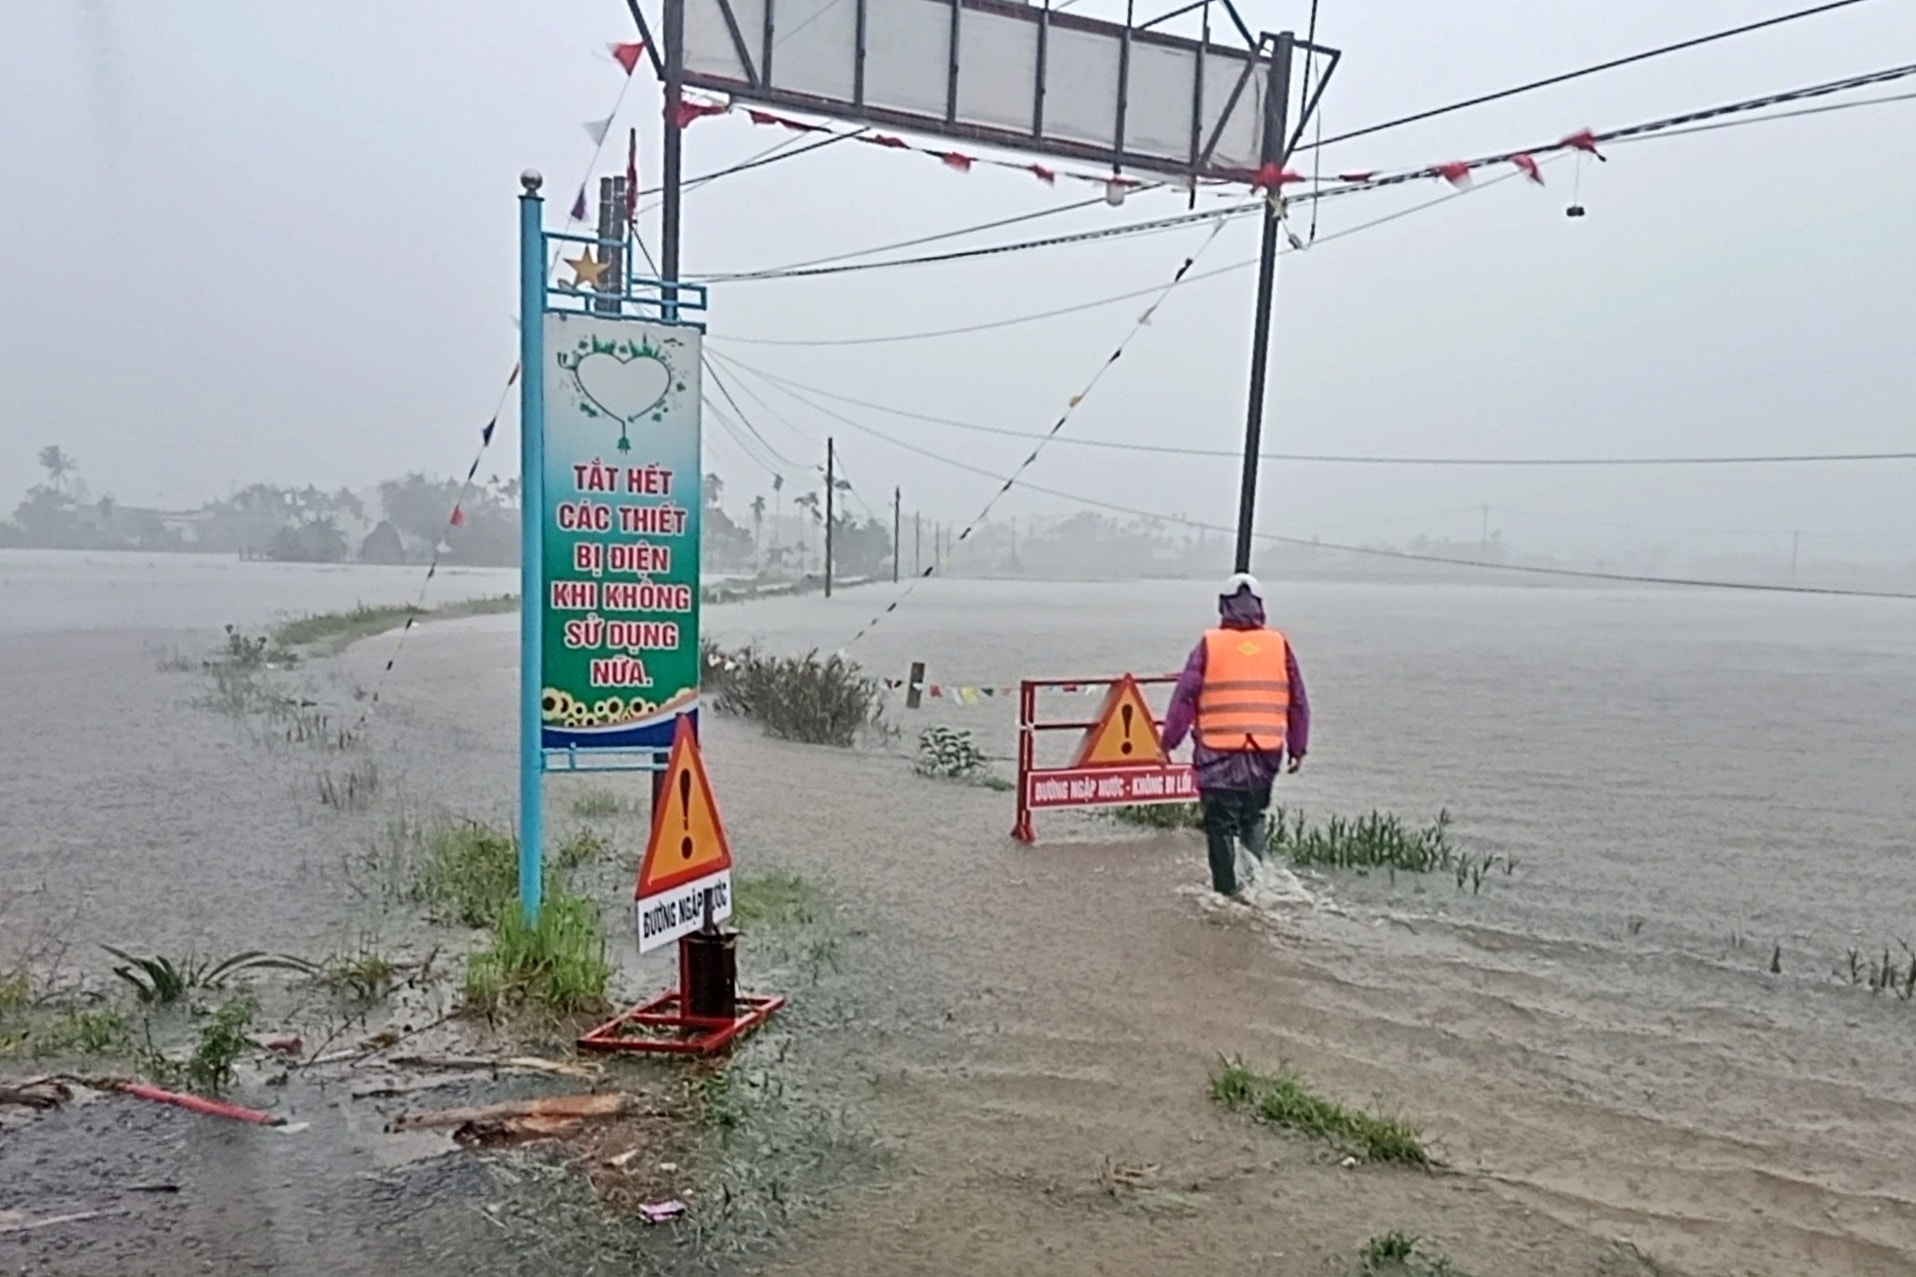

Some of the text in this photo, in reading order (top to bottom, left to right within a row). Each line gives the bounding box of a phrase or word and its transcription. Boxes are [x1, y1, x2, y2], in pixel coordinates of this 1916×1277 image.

[573, 457, 673, 495] TẮT HẾT
[558, 501, 687, 534] CÁC THIẾT
[575, 541, 669, 578] BỊ ĐIỆN
[552, 579, 690, 610] KHI KHÔNG
[566, 613, 678, 654] SỬ DỤNG
[591, 656, 652, 686] NỮA.
[644, 900, 676, 938] ĐƯỜNG
